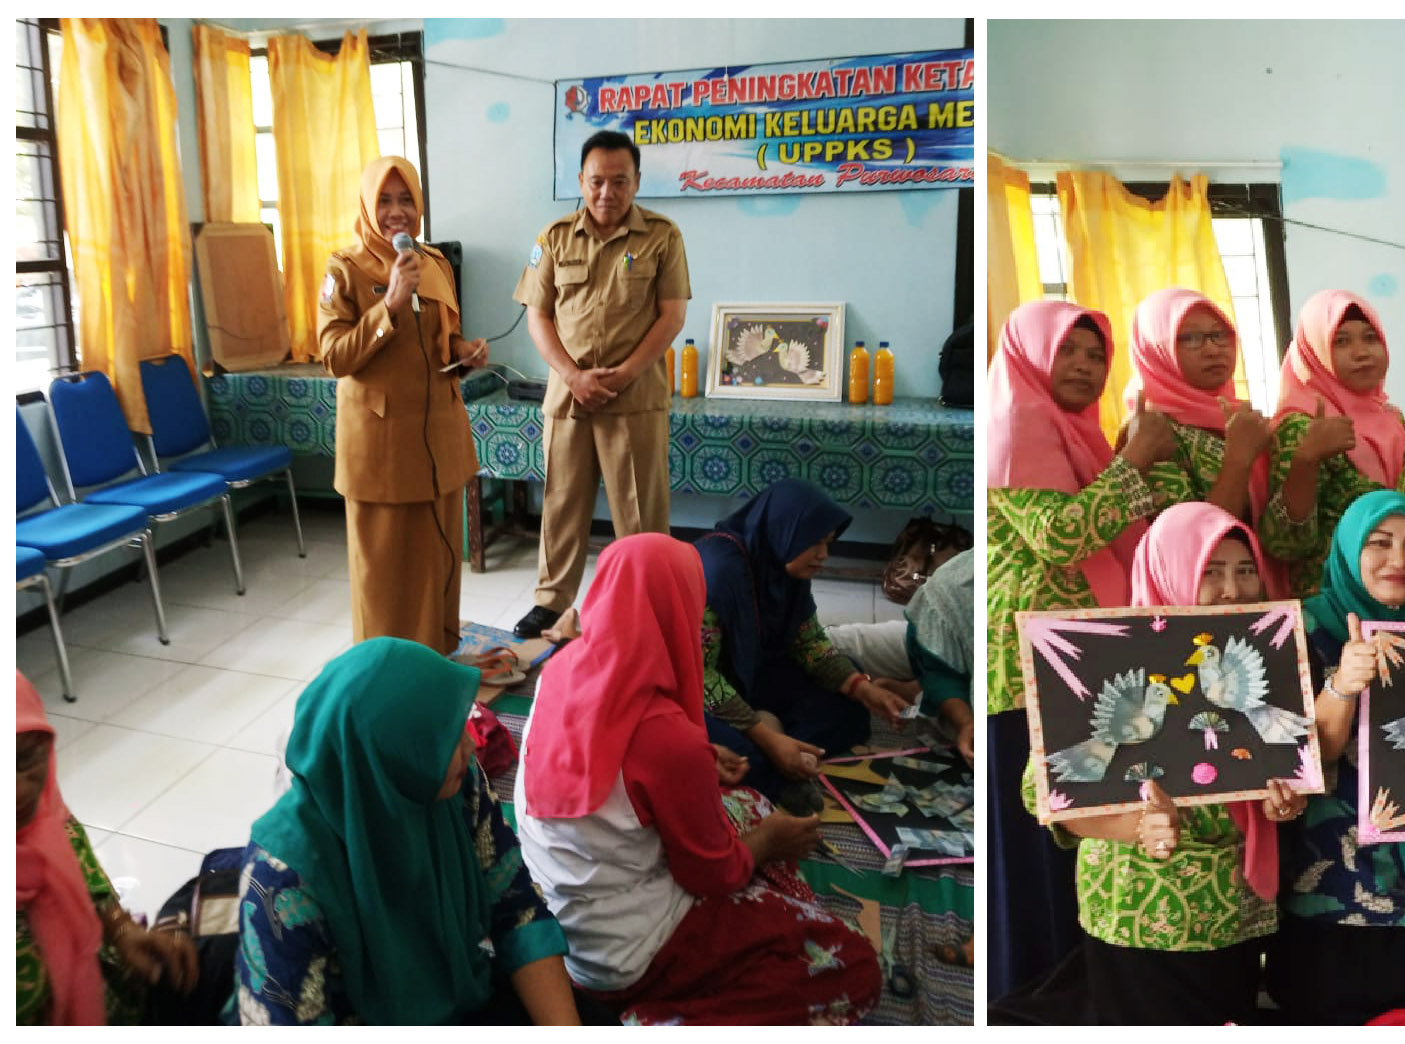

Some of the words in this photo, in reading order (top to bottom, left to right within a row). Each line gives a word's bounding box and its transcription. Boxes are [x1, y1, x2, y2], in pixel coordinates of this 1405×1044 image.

[598, 81, 688, 113] RAPAT
[692, 64, 897, 107] PENINGKATAN
[633, 113, 756, 146] EKONOMI
[763, 103, 918, 138] KELUARGA
[927, 100, 974, 129] ME
[778, 138, 893, 164] UPPKS
[678, 169, 825, 192] Kecamatan
